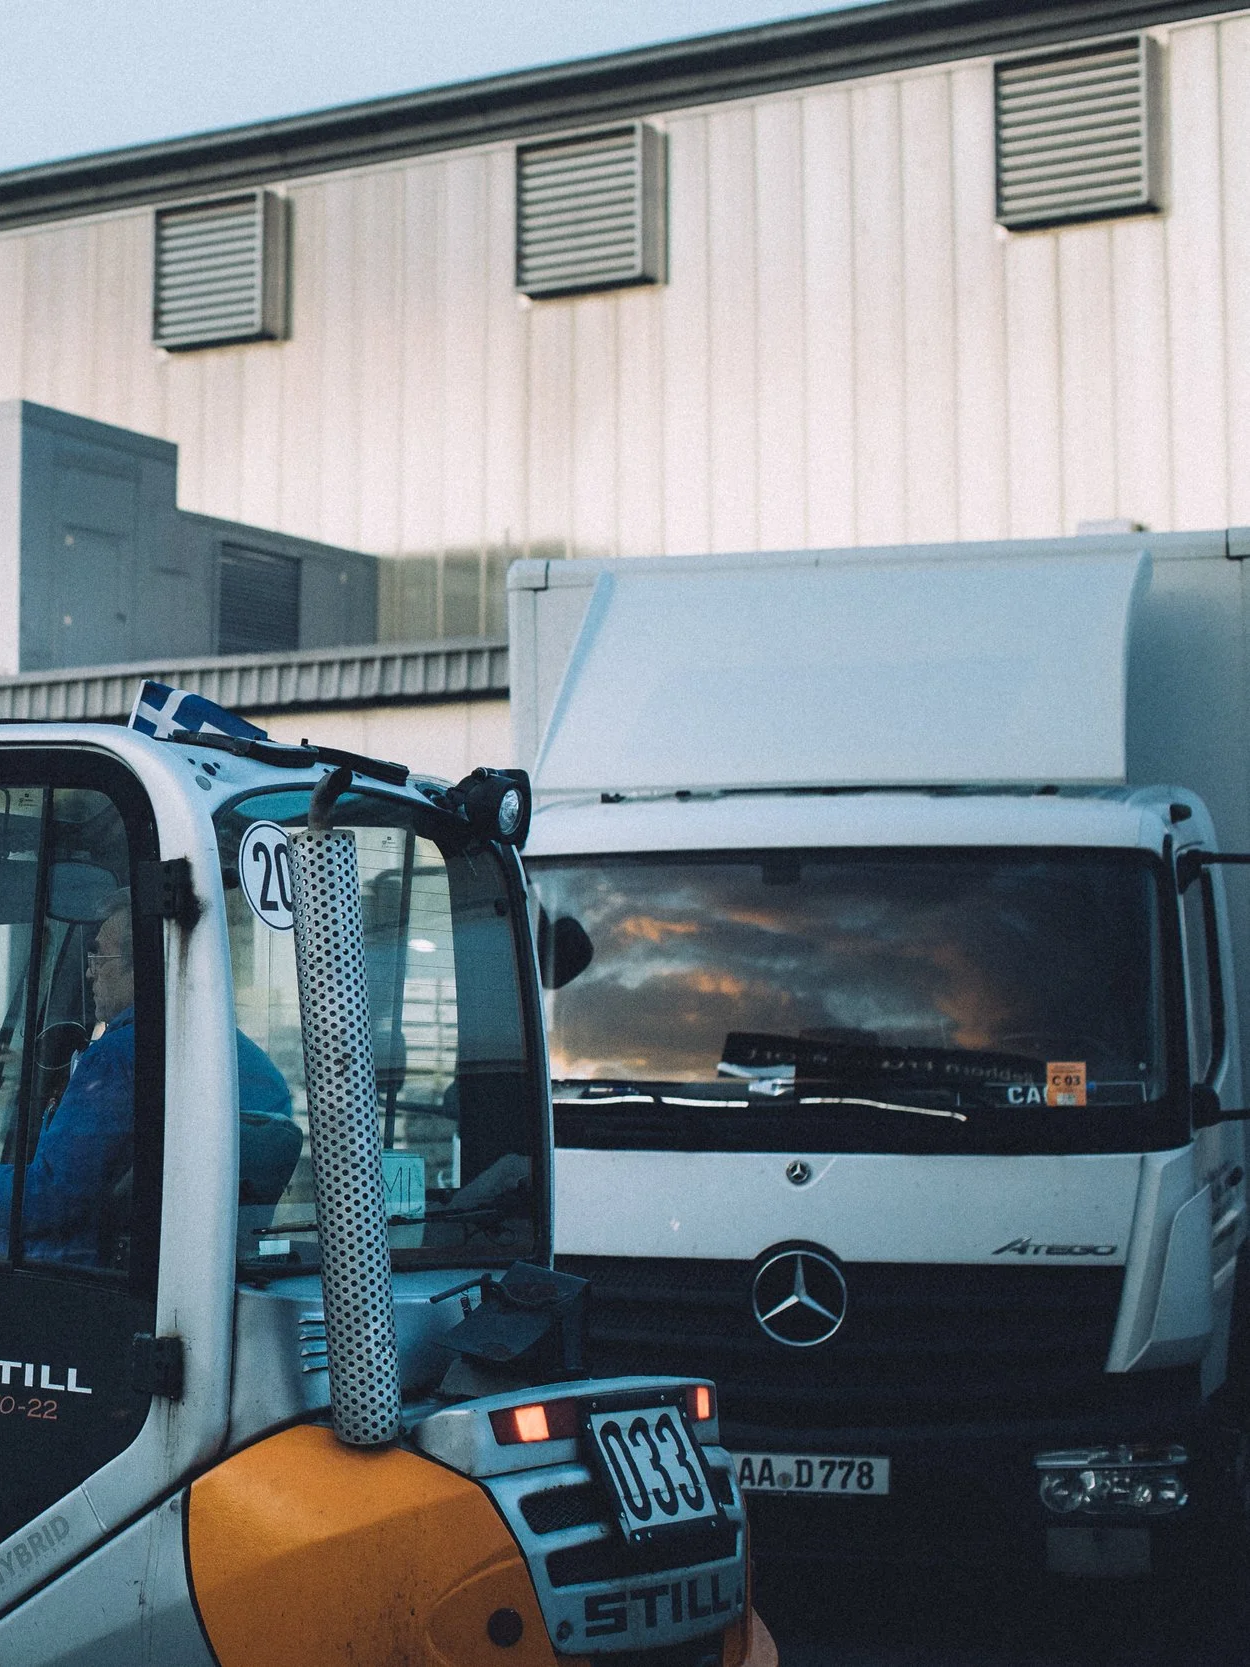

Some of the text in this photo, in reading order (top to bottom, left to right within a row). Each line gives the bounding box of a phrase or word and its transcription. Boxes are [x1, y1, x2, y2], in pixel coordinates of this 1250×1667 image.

[252, 841, 293, 912] 20
[1007, 1086, 1048, 1104] CA
[600, 1413, 704, 1521] 033
[739, 1457, 775, 1487] AA
[584, 1573, 732, 1638] STILL
